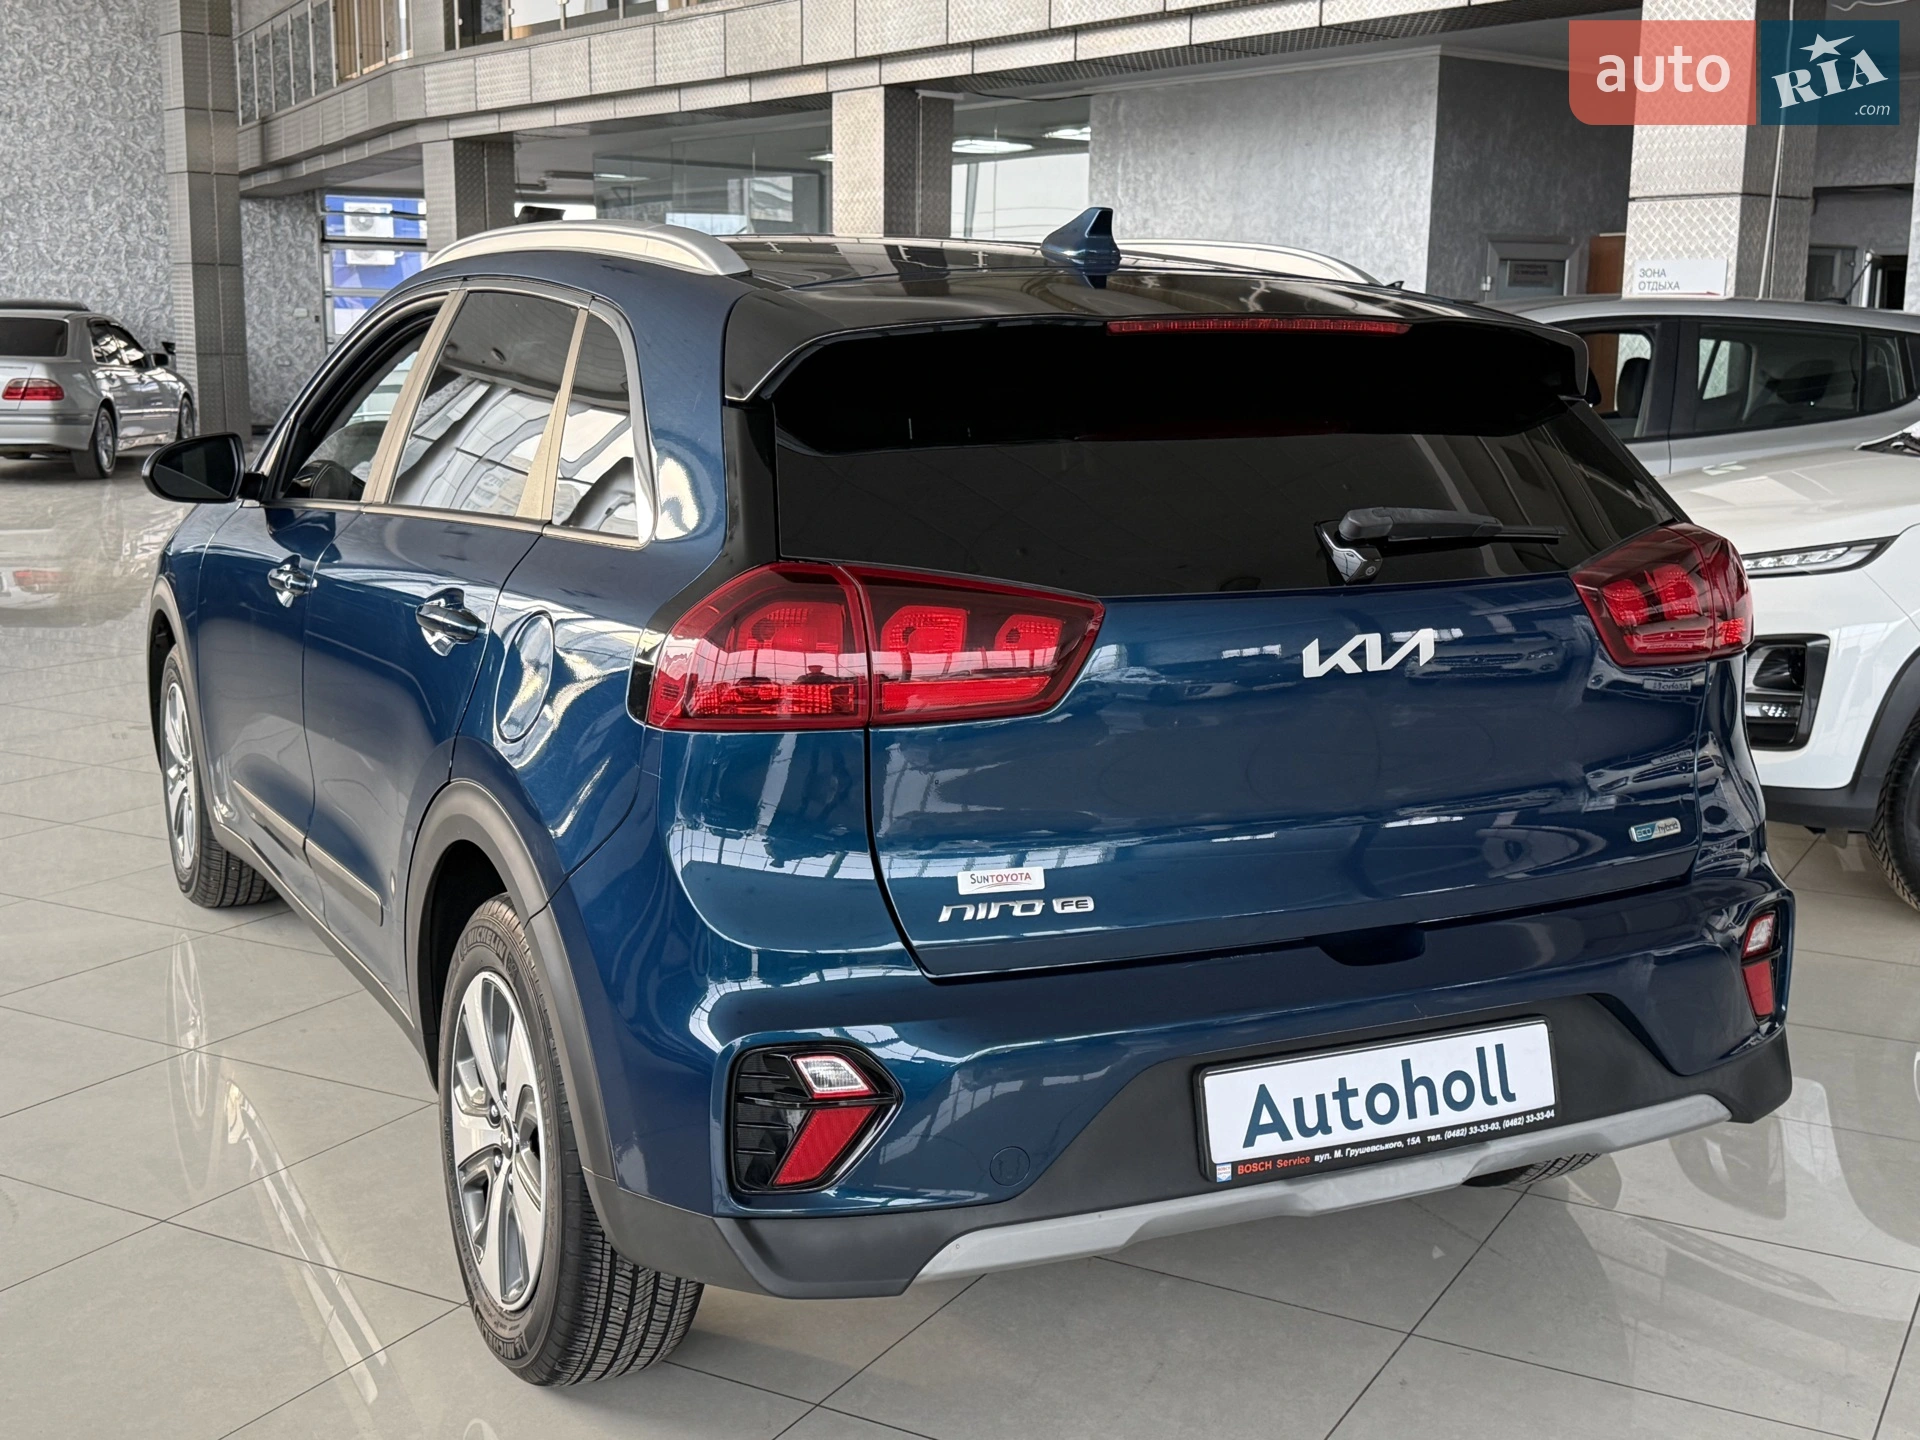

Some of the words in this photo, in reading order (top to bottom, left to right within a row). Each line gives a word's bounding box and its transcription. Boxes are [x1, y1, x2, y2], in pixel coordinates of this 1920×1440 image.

[1638, 281, 1680, 291] ОТДЫХА
[1639, 268, 1667, 278] ЗОНА
[1302, 628, 1435, 678] KIA
[1060, 899, 1089, 911] FE
[467, 926, 508, 959] MICHELIN
[1242, 1043, 1517, 1149] Autoholl
[1237, 1160, 1273, 1175] BOSCH
[1276, 1156, 1311, 1169] Service
[1314, 1152, 1332, 1163] вул.
[1333, 1149, 1343, 1158] М.
[1345, 1140, 1404, 1158] Грушевського,
[1427, 1134, 1442, 1143] тел.
[1444, 1126, 1467, 1140] (0482)
[1468, 1121, 1501, 1135] 33-33-03,
[1502, 1115, 1525, 1129] (0482)
[1525, 1109, 1555, 1123] 33-33-04
[475, 1315, 515, 1359] MICHELIN
